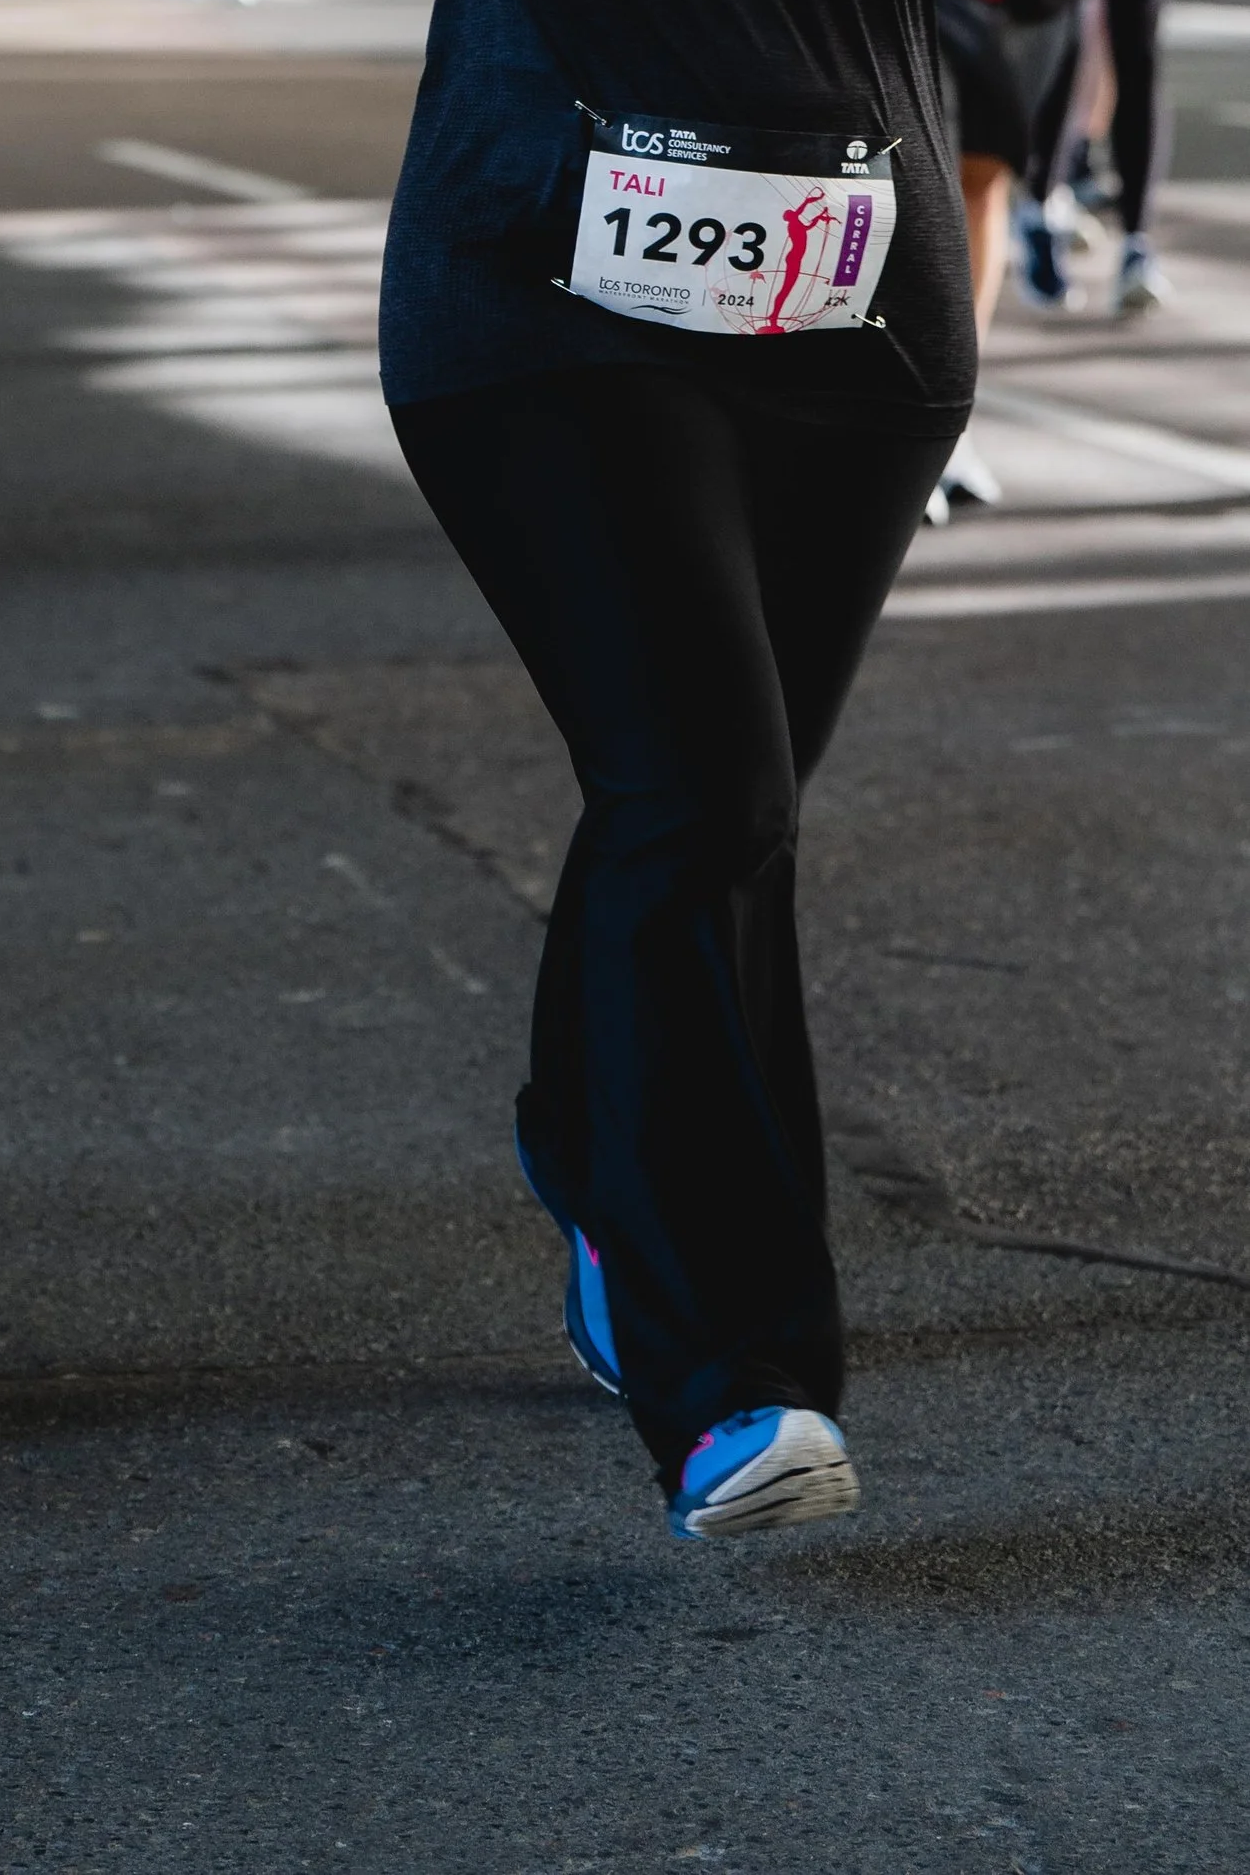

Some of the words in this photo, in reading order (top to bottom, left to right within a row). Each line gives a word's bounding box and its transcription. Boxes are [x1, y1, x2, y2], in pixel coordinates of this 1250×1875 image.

[621, 123, 665, 155] tcs
[669, 129, 697, 140] TATA
[666, 148, 708, 161] SERVICES
[667, 139, 732, 154] CONSULTANCY
[841, 162, 870, 174] TATA
[609, 170, 666, 197] TALI
[603, 207, 767, 272] 1293
[845, 205, 866, 274] CORRAL
[599, 276, 621, 291] tcs
[623, 281, 691, 300] TORONTO
[717, 293, 755, 307] 2024
